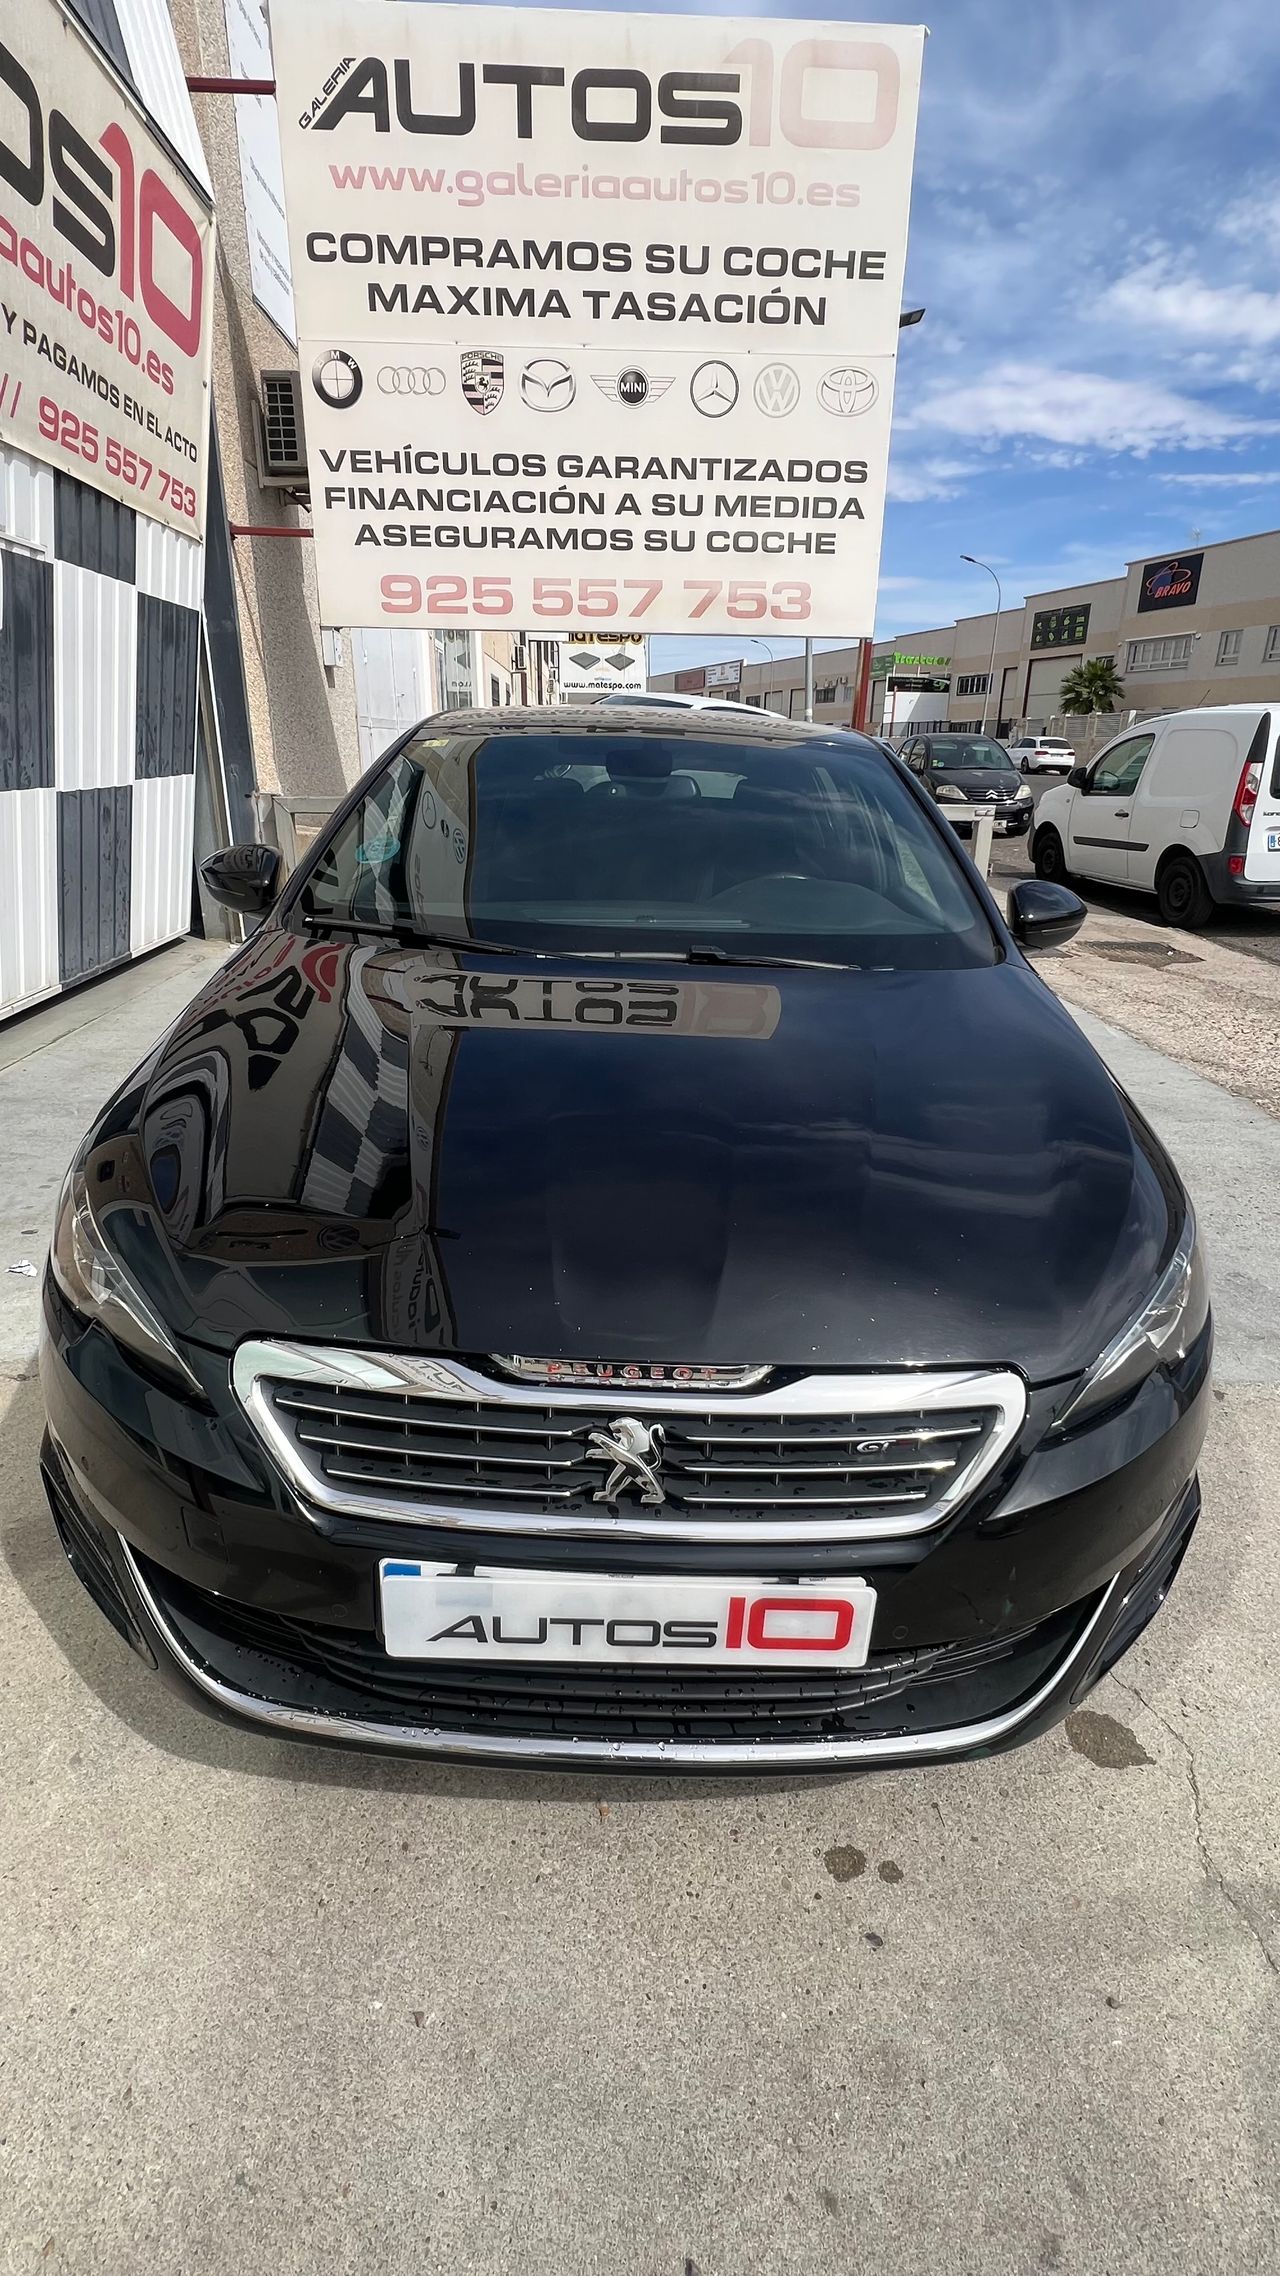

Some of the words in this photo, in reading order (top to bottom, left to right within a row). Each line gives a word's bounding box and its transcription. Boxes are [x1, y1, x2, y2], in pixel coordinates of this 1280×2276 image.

[298, 57, 357, 130] GALERIA
[328, 162, 861, 208] www.galeriaautos10.es
[305, 231, 632, 274] COMPRAMOS
[645, 240, 711, 276] SU
[722, 246, 888, 281] COCHE
[366, 282, 571, 320] MAXIMA
[582, 288, 827, 326] TASACIÓN
[22, 318, 120, 410] PAGAMOS
[123, 392, 144, 427] EN
[146, 410, 163, 440] EL
[164, 425, 197, 464] ACTO
[620, 380, 647, 394] MINI
[38, 396, 100, 464] 925
[105, 436, 153, 492] 557
[158, 468, 197, 518] 753
[319, 444, 547, 478] VEHÍCULOS
[556, 453, 869, 483] GARANTIZADOS
[323, 485, 605, 516] FINANCIACIÓN
[615, 493, 642, 516] A
[651, 494, 703, 517] SU
[714, 495, 866, 520] MEDIDA
[354, 523, 634, 552] ASEGURAMOS
[643, 530, 696, 553] SU
[705, 532, 837, 555] COCHE
[379, 574, 515, 616] 925
[531, 577, 664, 619] 557
[682, 580, 813, 621] 753
[1154, 581, 1192, 599] BRAVO
[564, 681, 642, 692] www.matespo.com
[547, 1362, 718, 1380] PEUGEOT
[426, 1596, 854, 1651] AUTOS10
